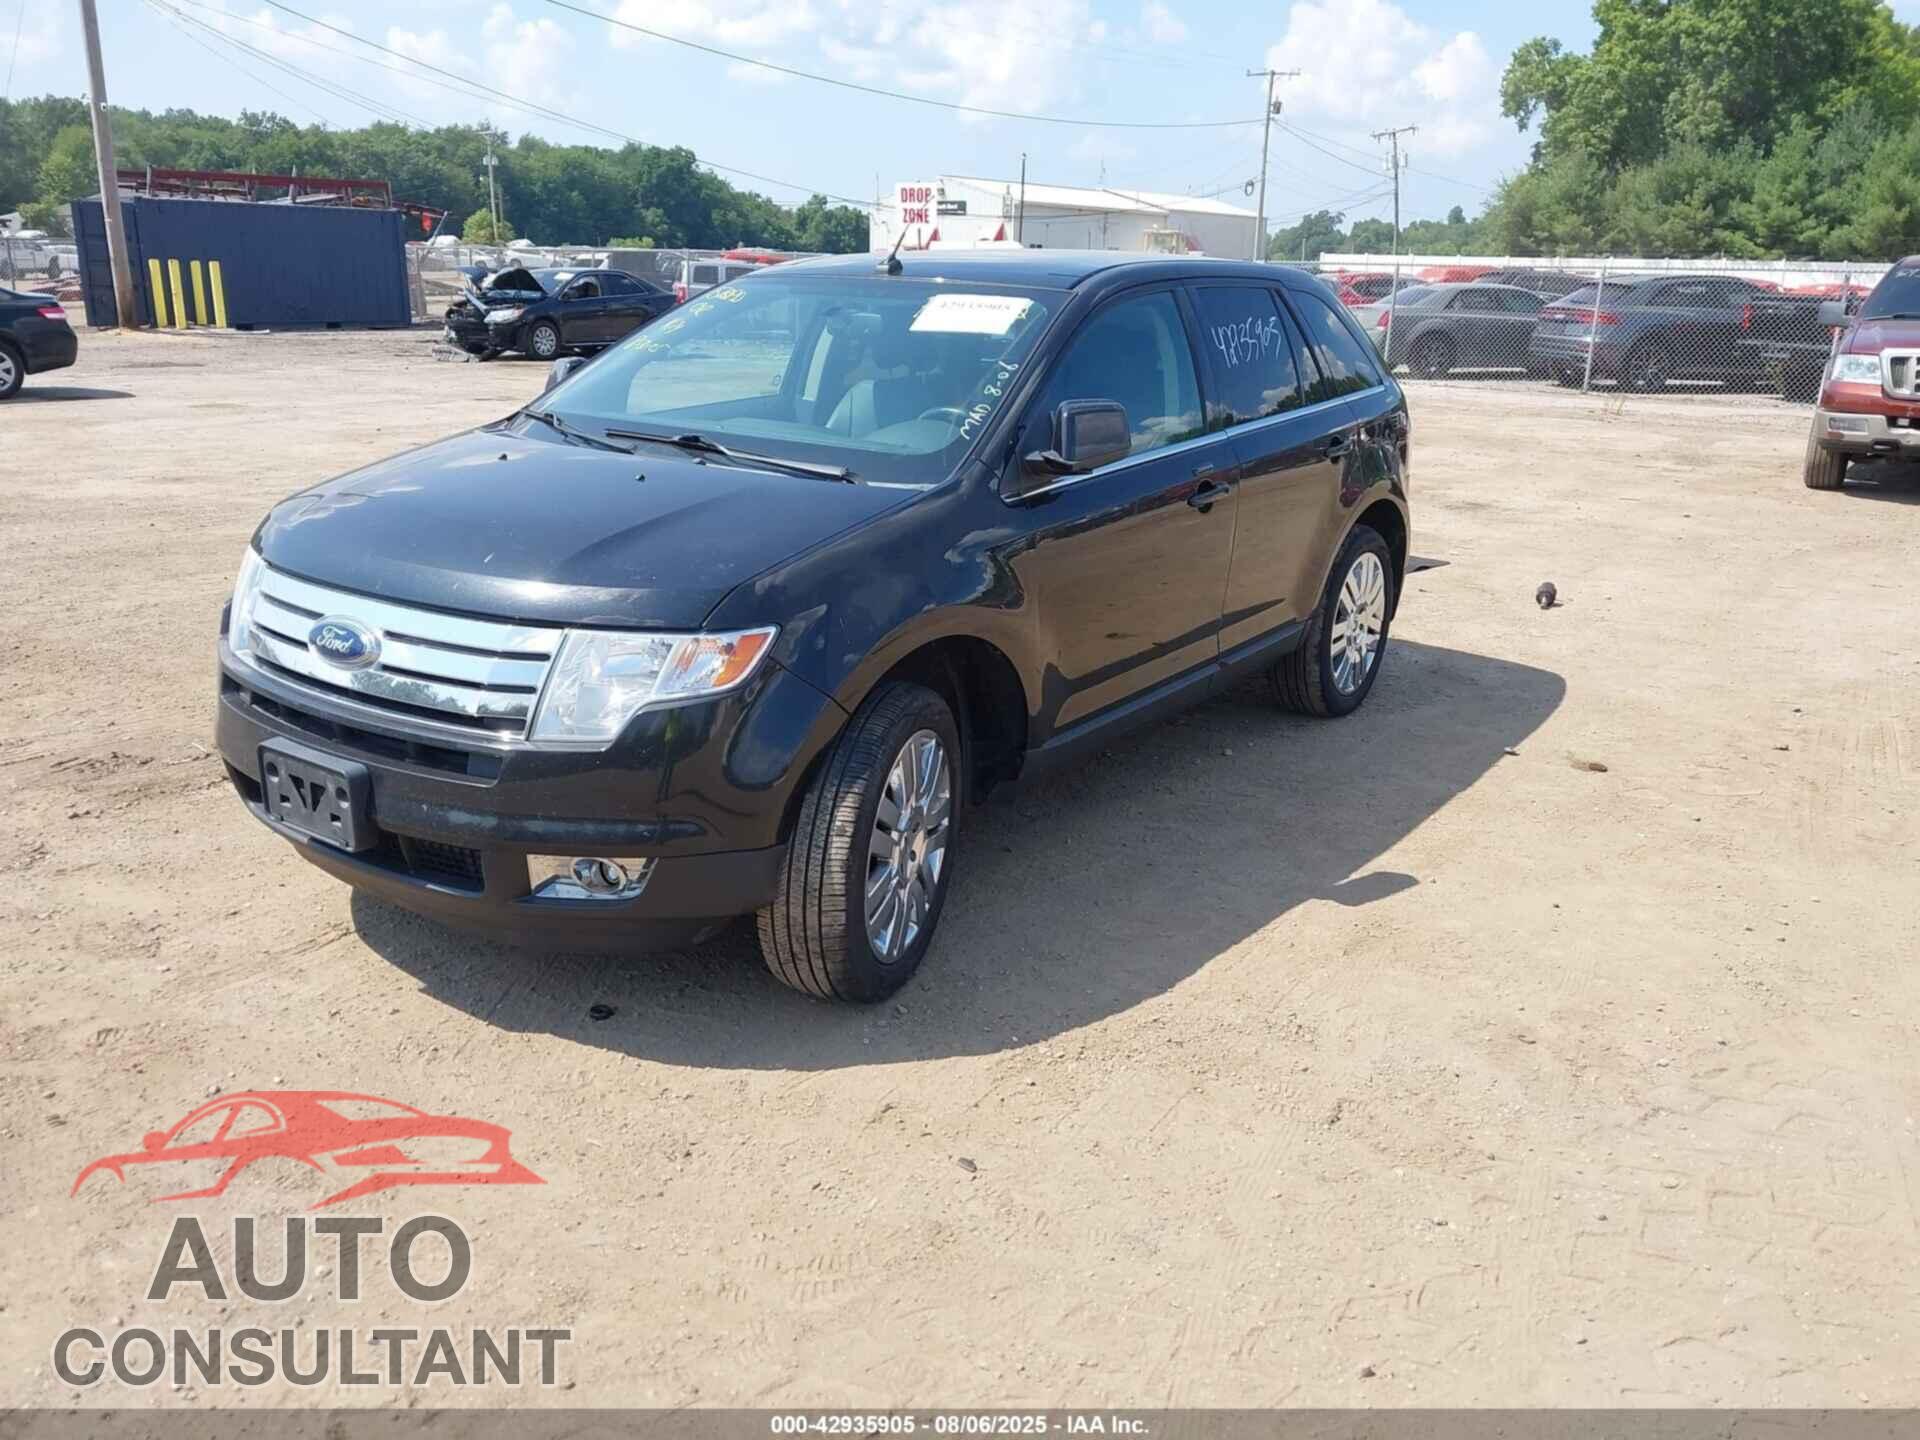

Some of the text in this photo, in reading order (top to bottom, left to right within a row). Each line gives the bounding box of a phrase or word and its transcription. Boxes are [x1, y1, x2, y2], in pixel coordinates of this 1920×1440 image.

[900, 187, 932, 203] DROP
[903, 208, 929, 224] ZONE
[316, 625, 354, 654] Ford
